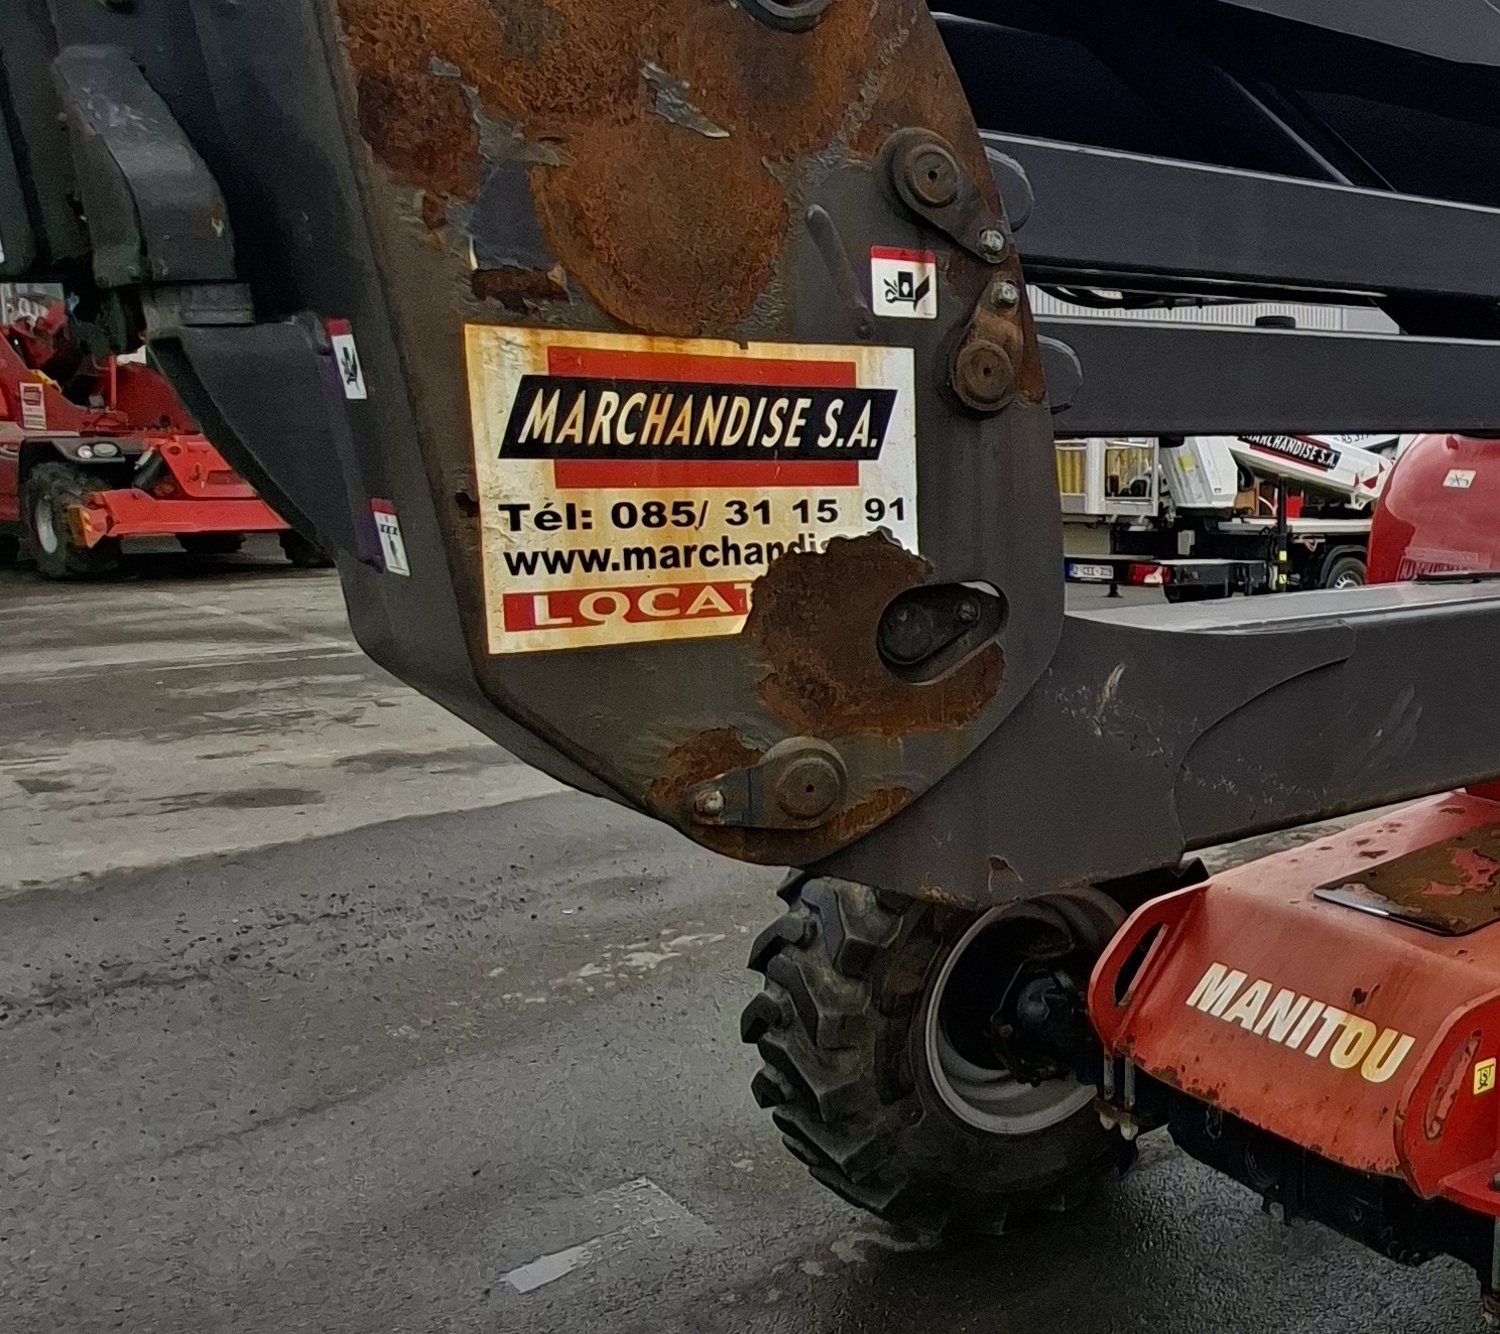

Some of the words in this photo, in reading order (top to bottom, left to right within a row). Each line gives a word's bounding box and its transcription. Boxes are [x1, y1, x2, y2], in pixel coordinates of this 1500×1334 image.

[518, 387, 811, 448] MARCHANDISE
[817, 397, 879, 449] S.A.
[498, 501, 593, 532] Tél:
[611, 499, 709, 530] 085/
[724, 499, 771, 525] 31
[792, 498, 838, 523] 15
[864, 497, 905, 522] 91
[1185, 961, 1416, 1083] MANITOU
